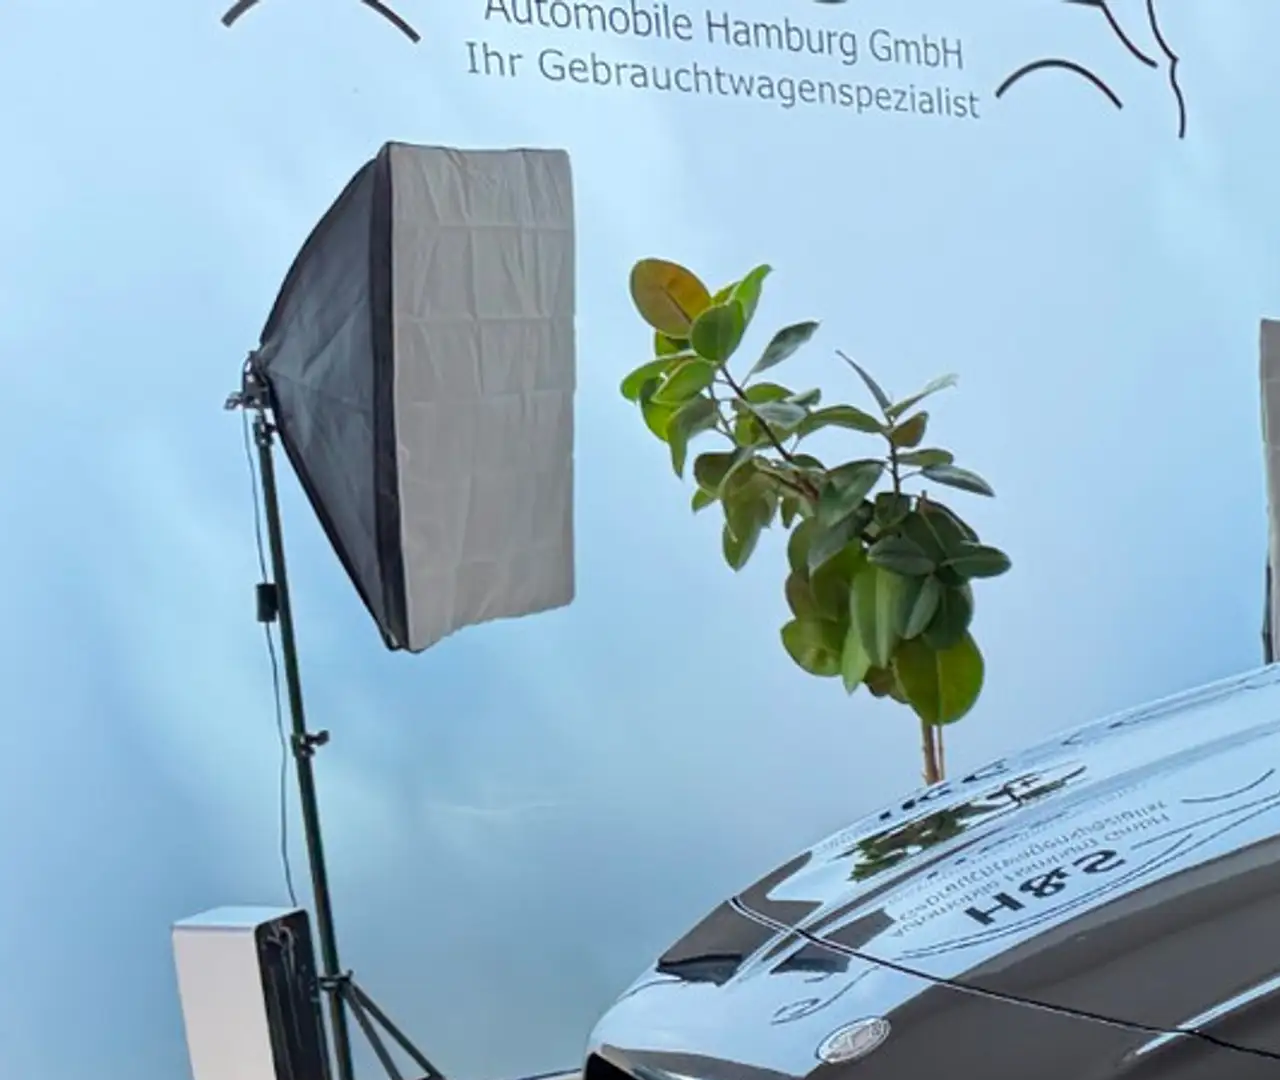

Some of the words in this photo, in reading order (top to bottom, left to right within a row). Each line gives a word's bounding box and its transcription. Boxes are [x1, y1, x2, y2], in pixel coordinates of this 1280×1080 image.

[485, 0, 693, 41] Automobile
[706, 10, 858, 66] Hamburg
[869, 28, 964, 70] GmbH
[465, 41, 524, 78] Ihr
[538, 48, 981, 119] Gebrauchtwagenspezialist
